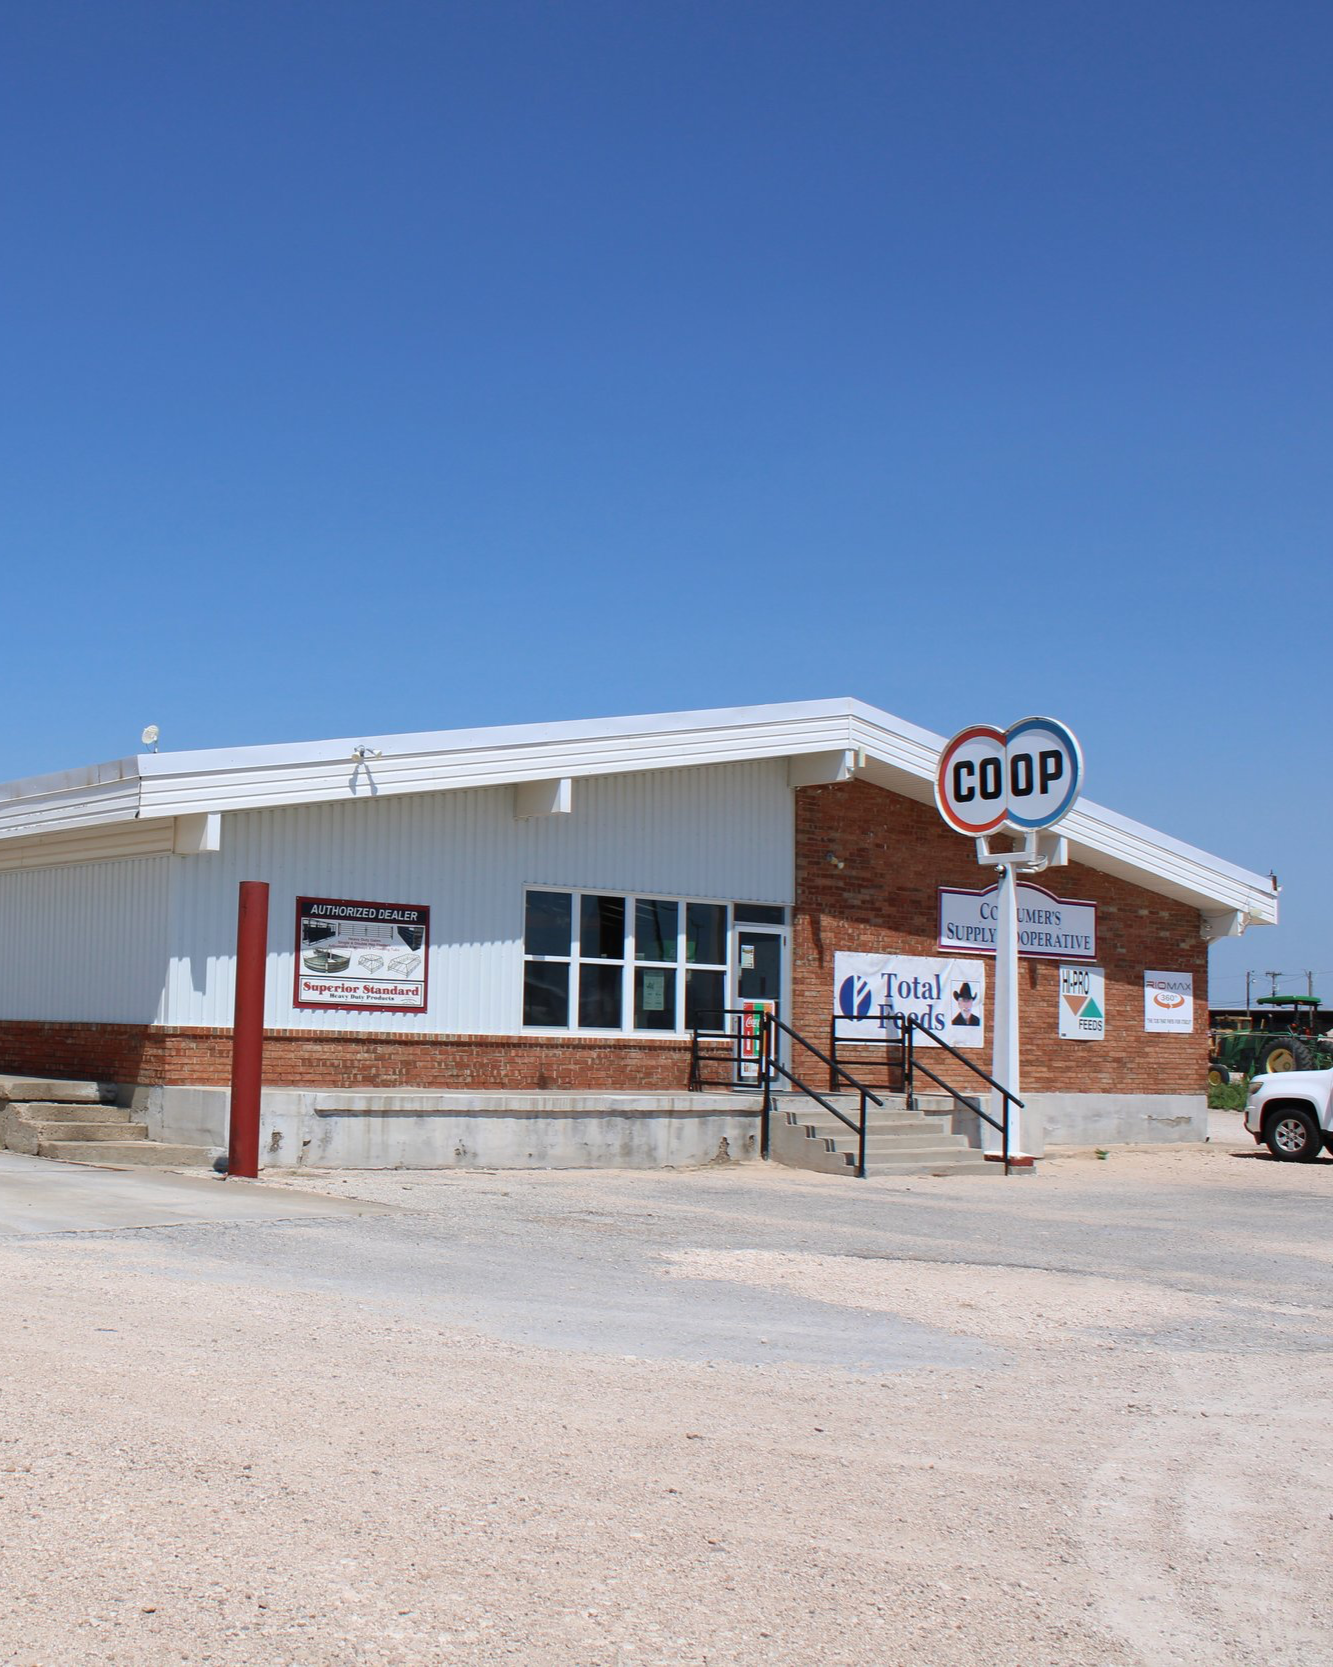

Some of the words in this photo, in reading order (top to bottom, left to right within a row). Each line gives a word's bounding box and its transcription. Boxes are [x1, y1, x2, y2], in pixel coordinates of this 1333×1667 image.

[310, 904, 376, 919] AUTHORIZED
[378, 909, 418, 921] DEALER
[979, 902, 1061, 926] COUMER'S
[946, 922, 997, 943] SUPPLY
[1017, 930, 1091, 950] OPERATIVE
[302, 981, 360, 995] Superior
[362, 984, 419, 996] Standard
[881, 972, 942, 1000] Total
[1061, 969, 1090, 995] HI-PRO
[1145, 980, 1192, 991] RIOMAX
[329, 993, 348, 1001] Heavy
[877, 1003, 946, 1031] Feeds
[1078, 1018, 1103, 1032] FEEDS
